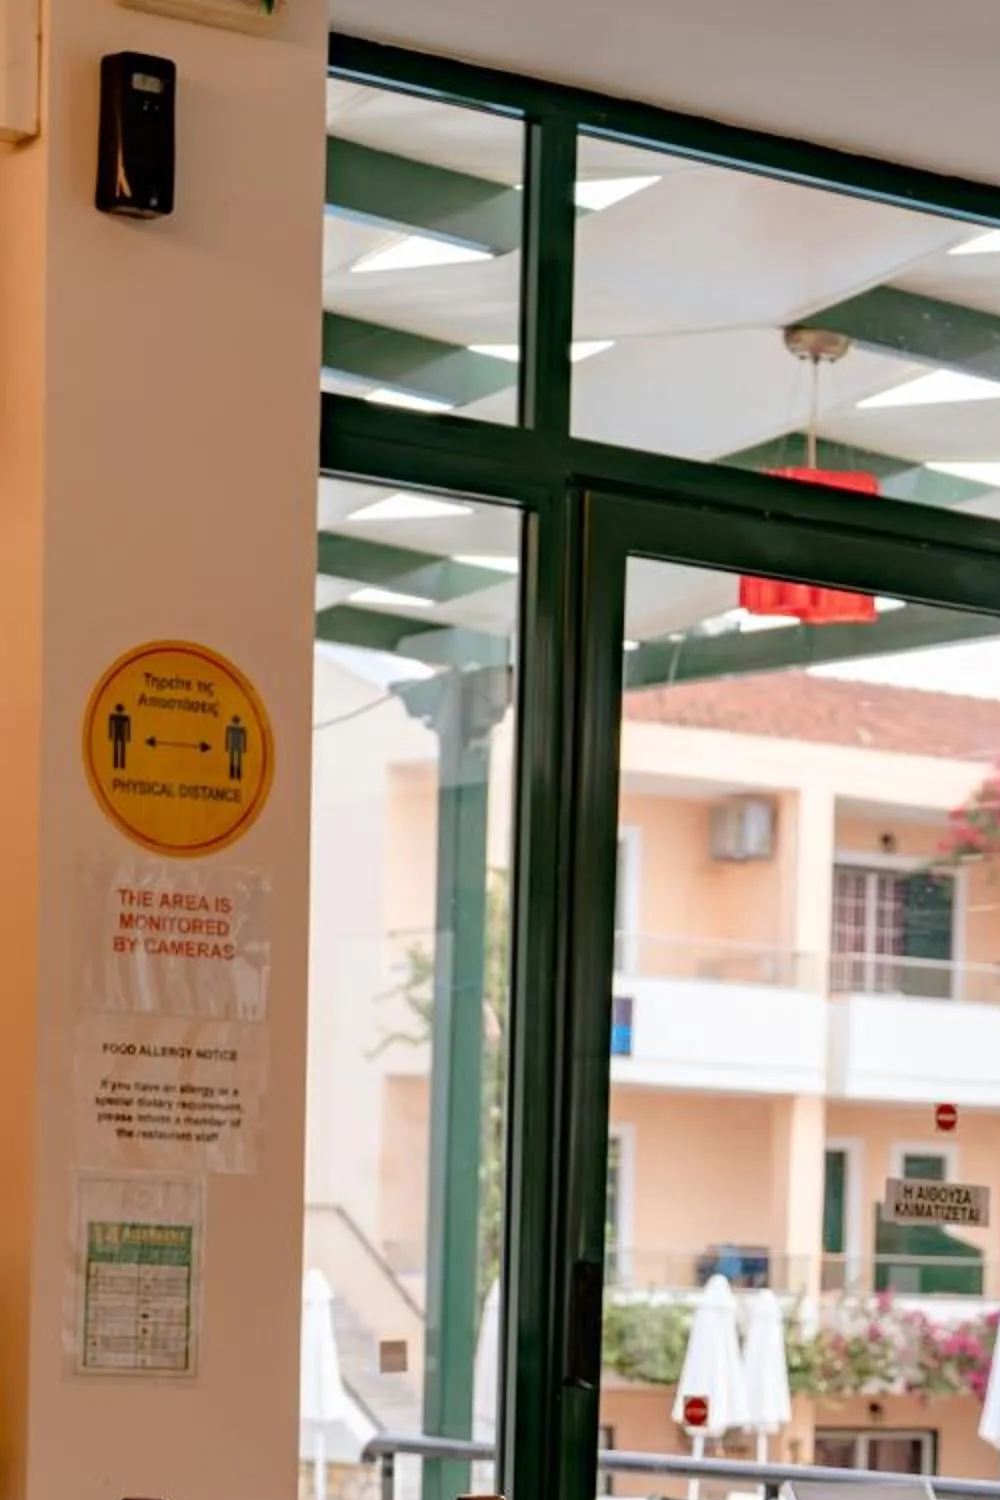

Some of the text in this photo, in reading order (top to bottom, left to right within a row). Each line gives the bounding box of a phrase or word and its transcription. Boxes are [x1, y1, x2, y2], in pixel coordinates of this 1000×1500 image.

[112, 777, 242, 804] PHYSICAL DISTANCE
[117, 888, 232, 913] THE AREA IS
[119, 913, 230, 937] MONITORED
[113, 935, 235, 961] BY CAMERAS
[102, 1043, 238, 1062] FOOD ALLERGY NOTICE
